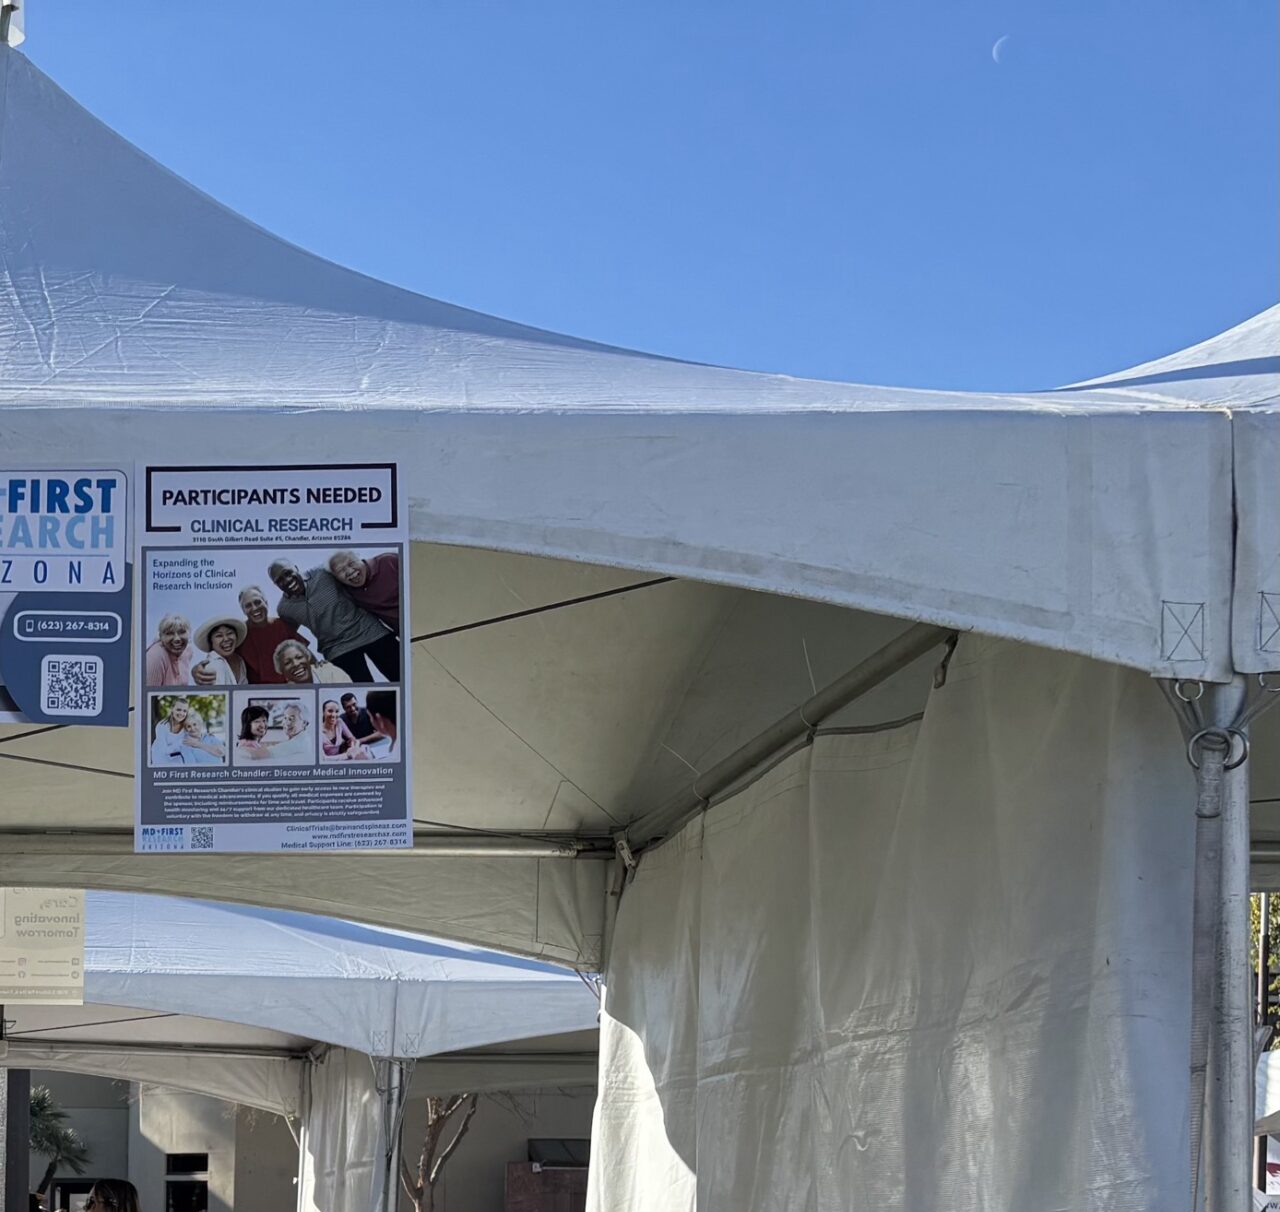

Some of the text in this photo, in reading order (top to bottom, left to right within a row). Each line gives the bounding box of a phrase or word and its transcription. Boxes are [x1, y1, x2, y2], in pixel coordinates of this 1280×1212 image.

[7, 479, 116, 513] FIRST
[162, 486, 382, 506] PARTICIPANTS NEEDED
[191, 518, 353, 533] CLINICAL RESEARCH
